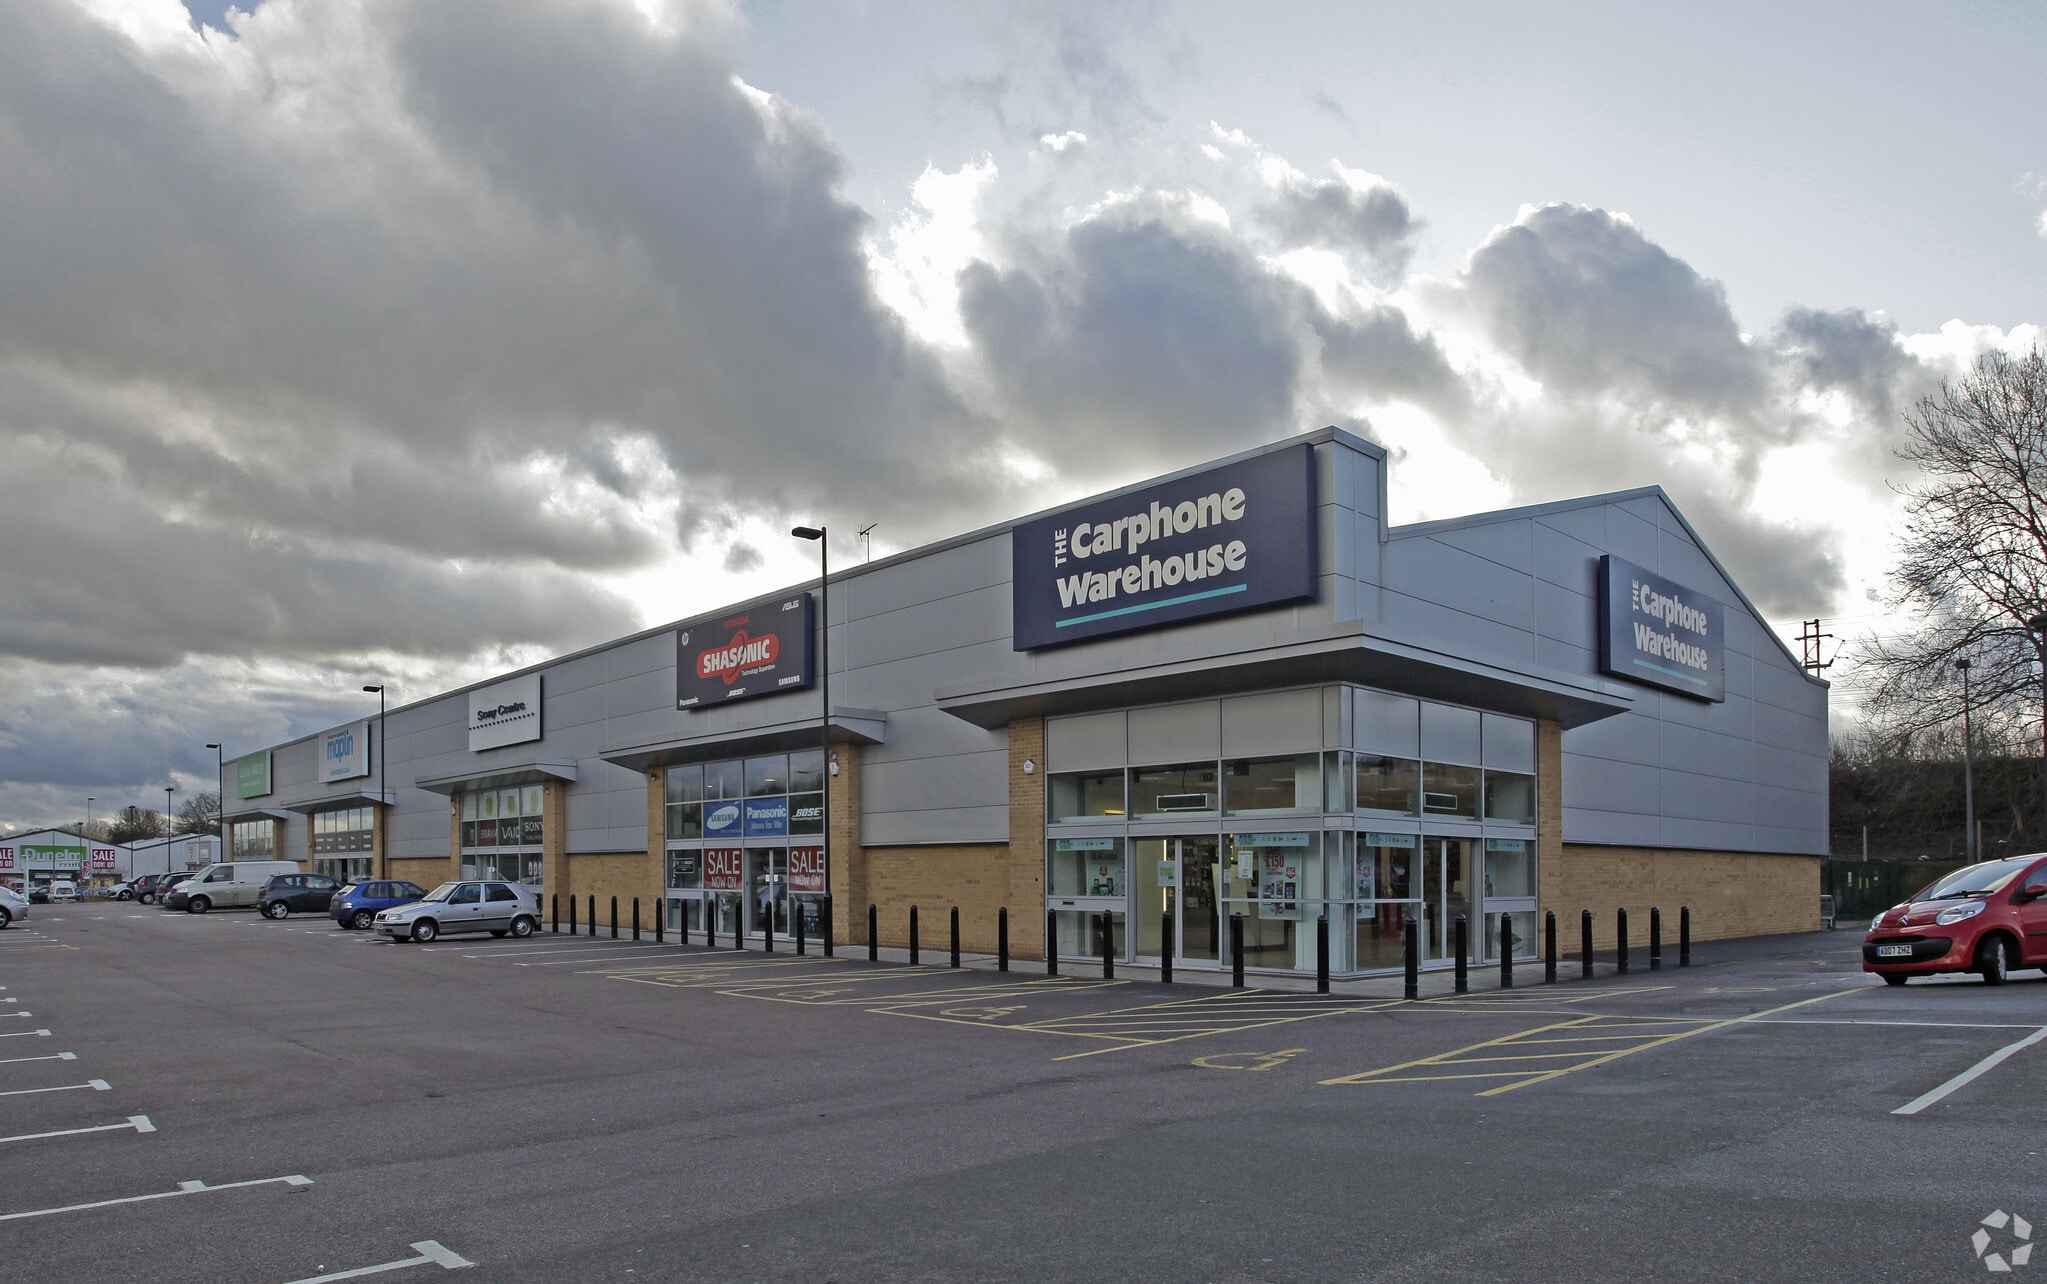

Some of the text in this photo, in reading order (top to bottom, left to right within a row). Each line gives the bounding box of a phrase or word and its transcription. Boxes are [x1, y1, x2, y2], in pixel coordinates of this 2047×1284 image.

[1055, 487, 1246, 568] THE Carphone
[1056, 540, 1247, 608] Warehouse
[782, 600, 799, 611] ASUS
[1640, 584, 1708, 636] Carphone
[1633, 621, 1708, 671] Warehouse
[703, 639, 770, 674] SHASONIC
[778, 675, 800, 686] SAMSUNG
[477, 701, 526, 721] Sony Centre
[326, 729, 354, 764] maplin
[711, 813, 735, 823] SAMSUNG
[746, 805, 787, 819] Panasonic
[792, 807, 823, 817] BOSE
[524, 821, 543, 832] SONY
[765, 820, 773, 829] for
[773, 819, 783, 829] life
[24, 848, 84, 861] Dunelm
[93, 850, 115, 860] SALE
[106, 860, 115, 868] on
[707, 850, 741, 875] SALE
[791, 850, 825, 874] SALE
[1265, 855, 1285, 868] £150
[711, 876, 737, 889] NOW ON
[794, 874, 821, 886] NOW ON
